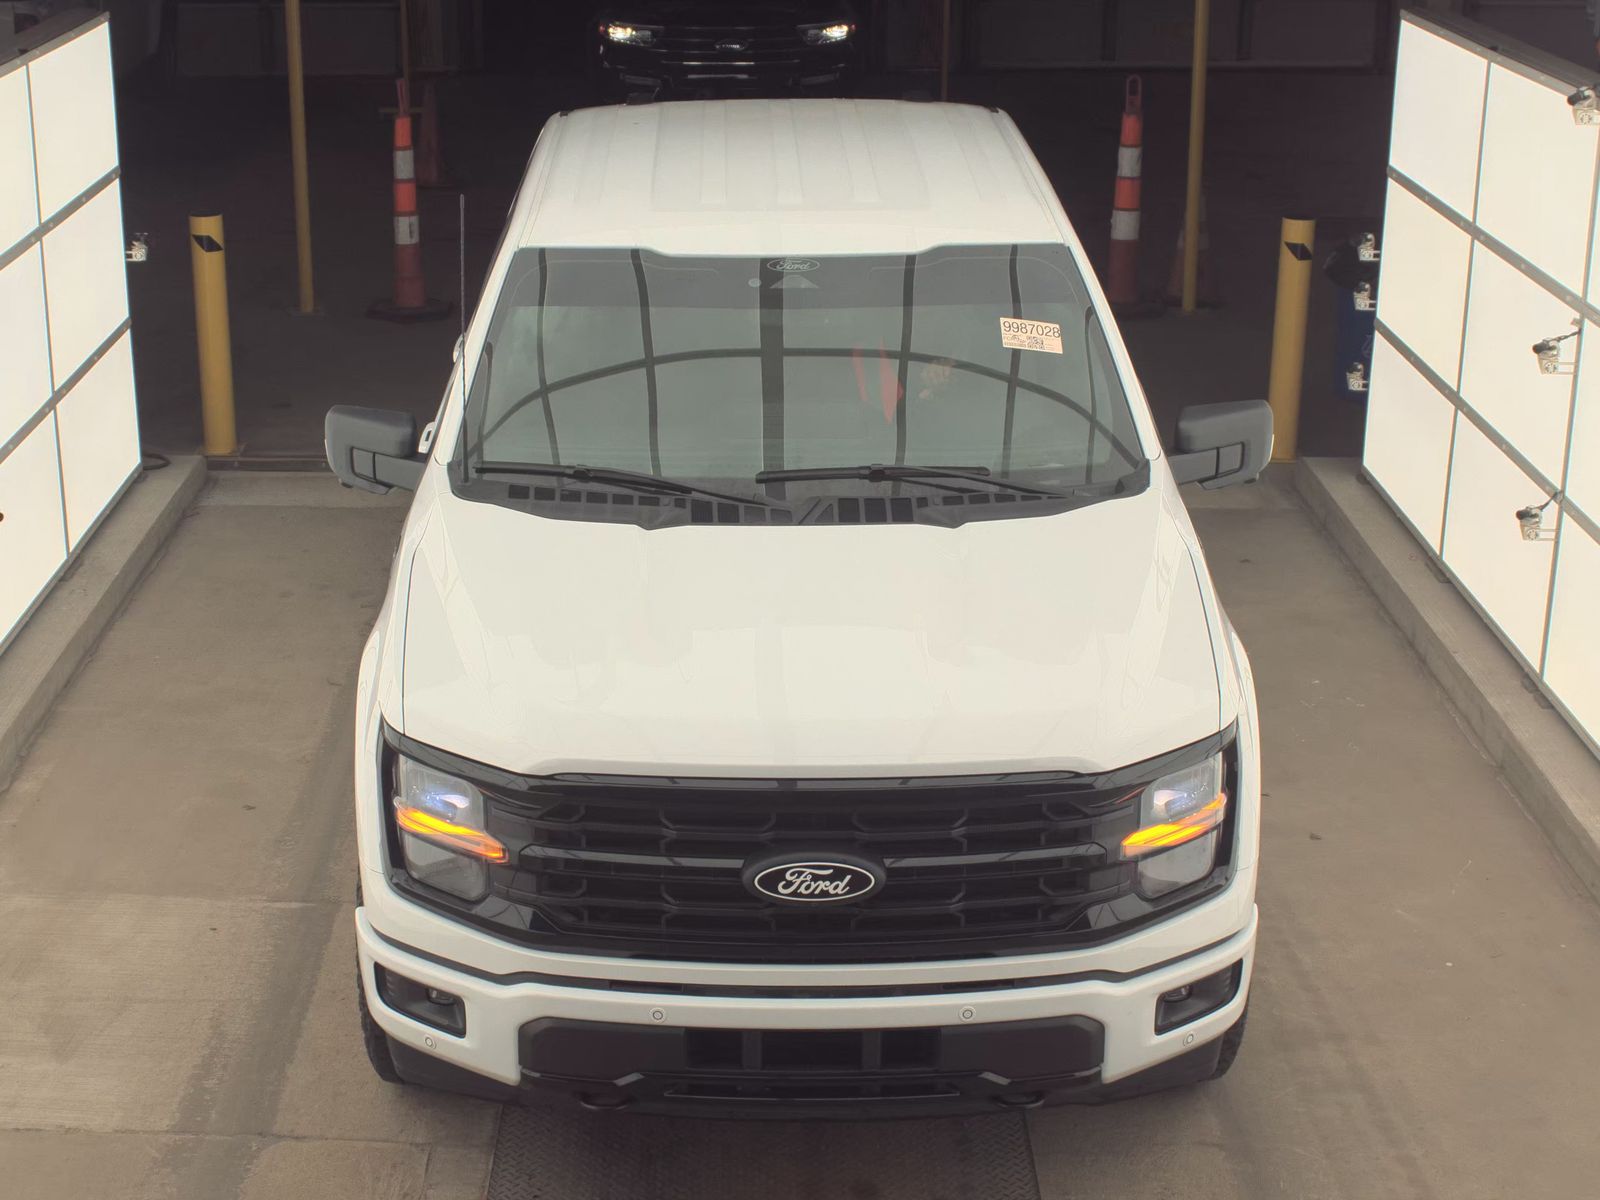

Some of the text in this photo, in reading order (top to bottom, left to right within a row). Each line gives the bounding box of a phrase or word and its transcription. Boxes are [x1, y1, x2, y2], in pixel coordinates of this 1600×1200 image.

[776, 259, 811, 270] Ford
[1003, 320, 1061, 338] 9987028
[777, 867, 852, 894] Ford
